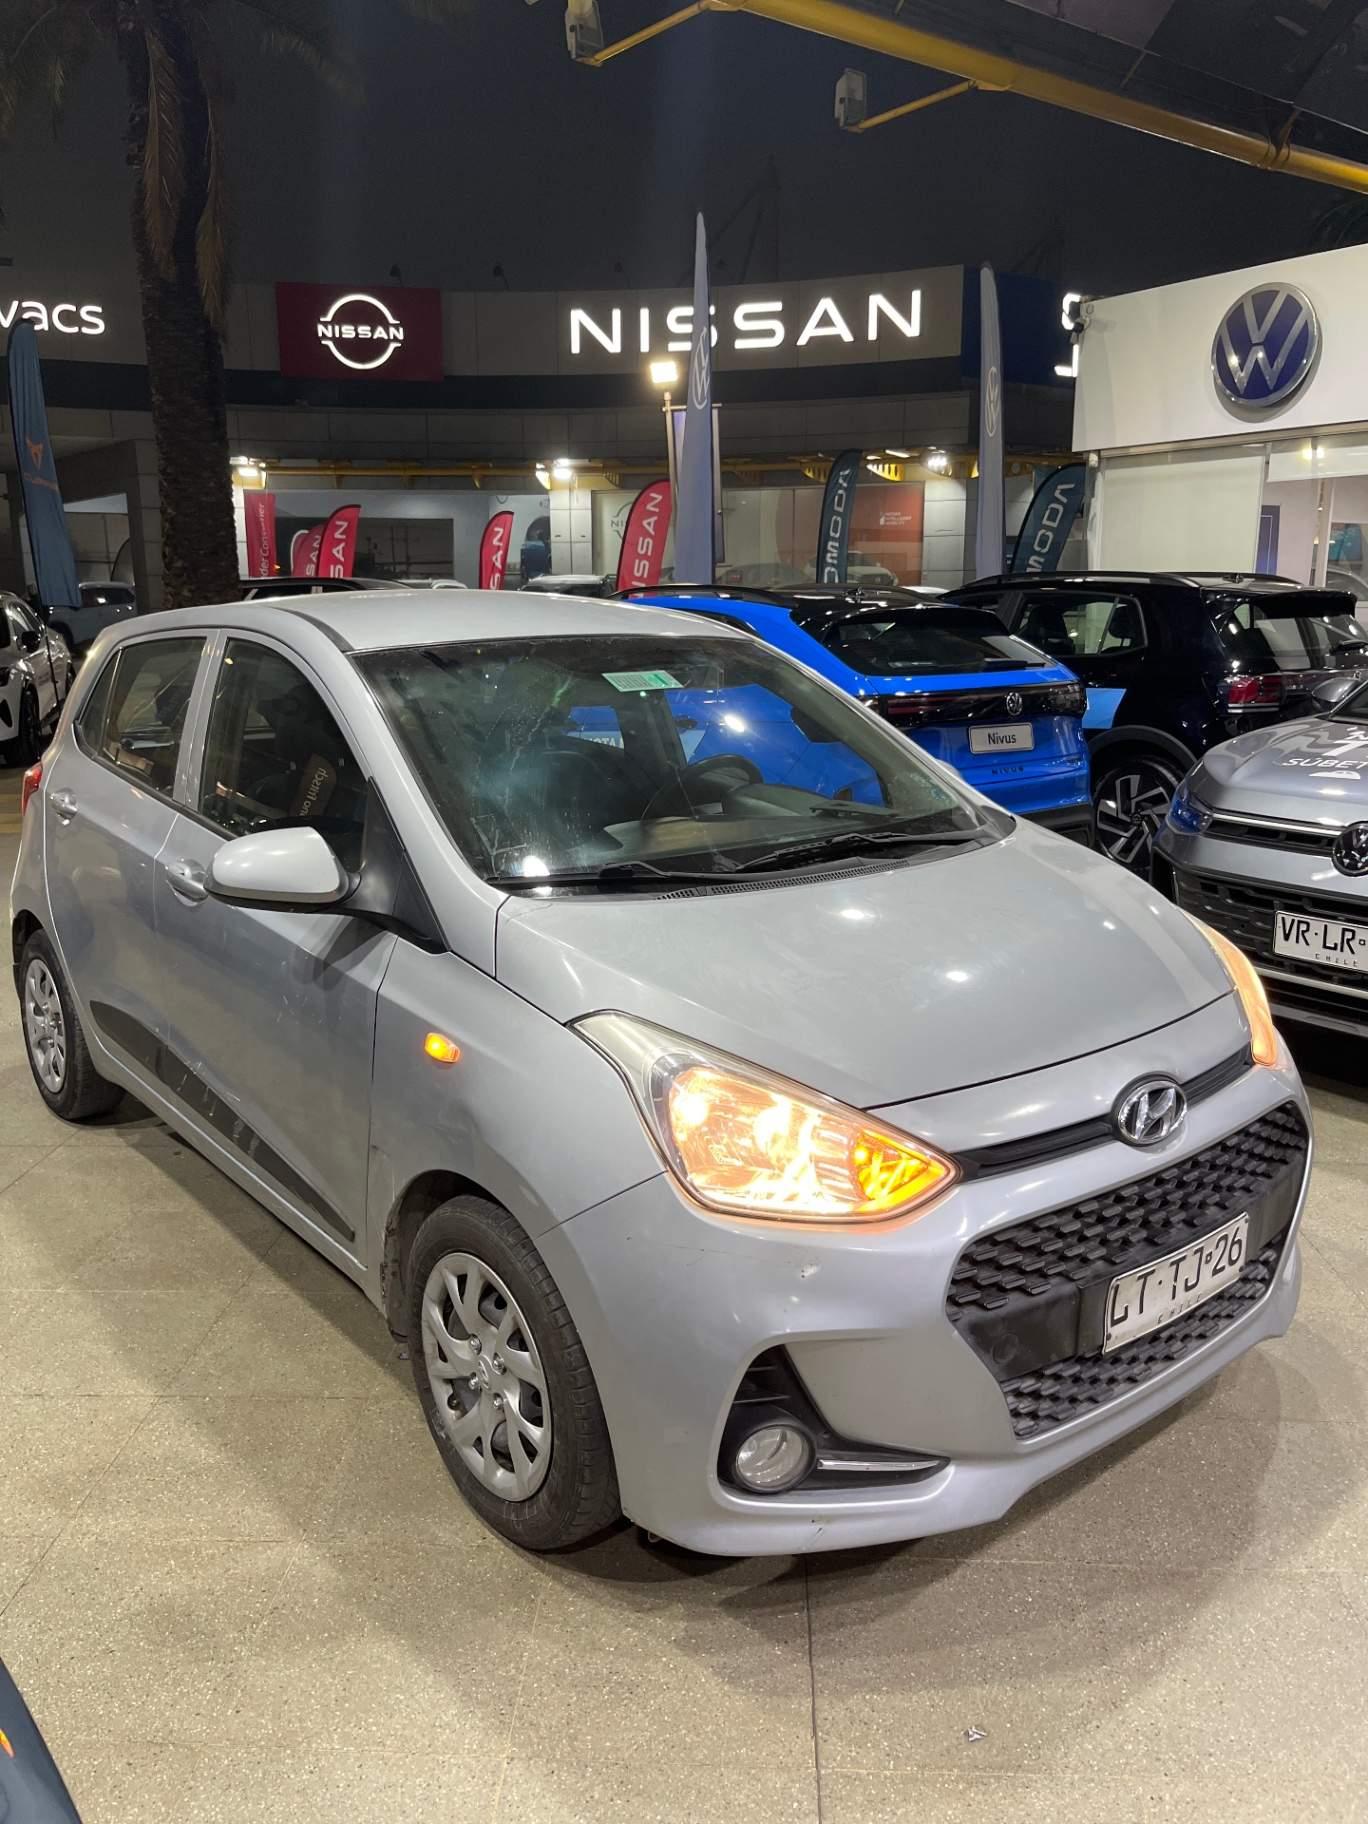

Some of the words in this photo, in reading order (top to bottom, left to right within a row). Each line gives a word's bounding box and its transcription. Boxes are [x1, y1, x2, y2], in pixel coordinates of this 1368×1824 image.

[570, 289, 922, 355] NISSAN
[317, 324, 404, 340] NISSAN
[987, 732, 1017, 745] Nivus
